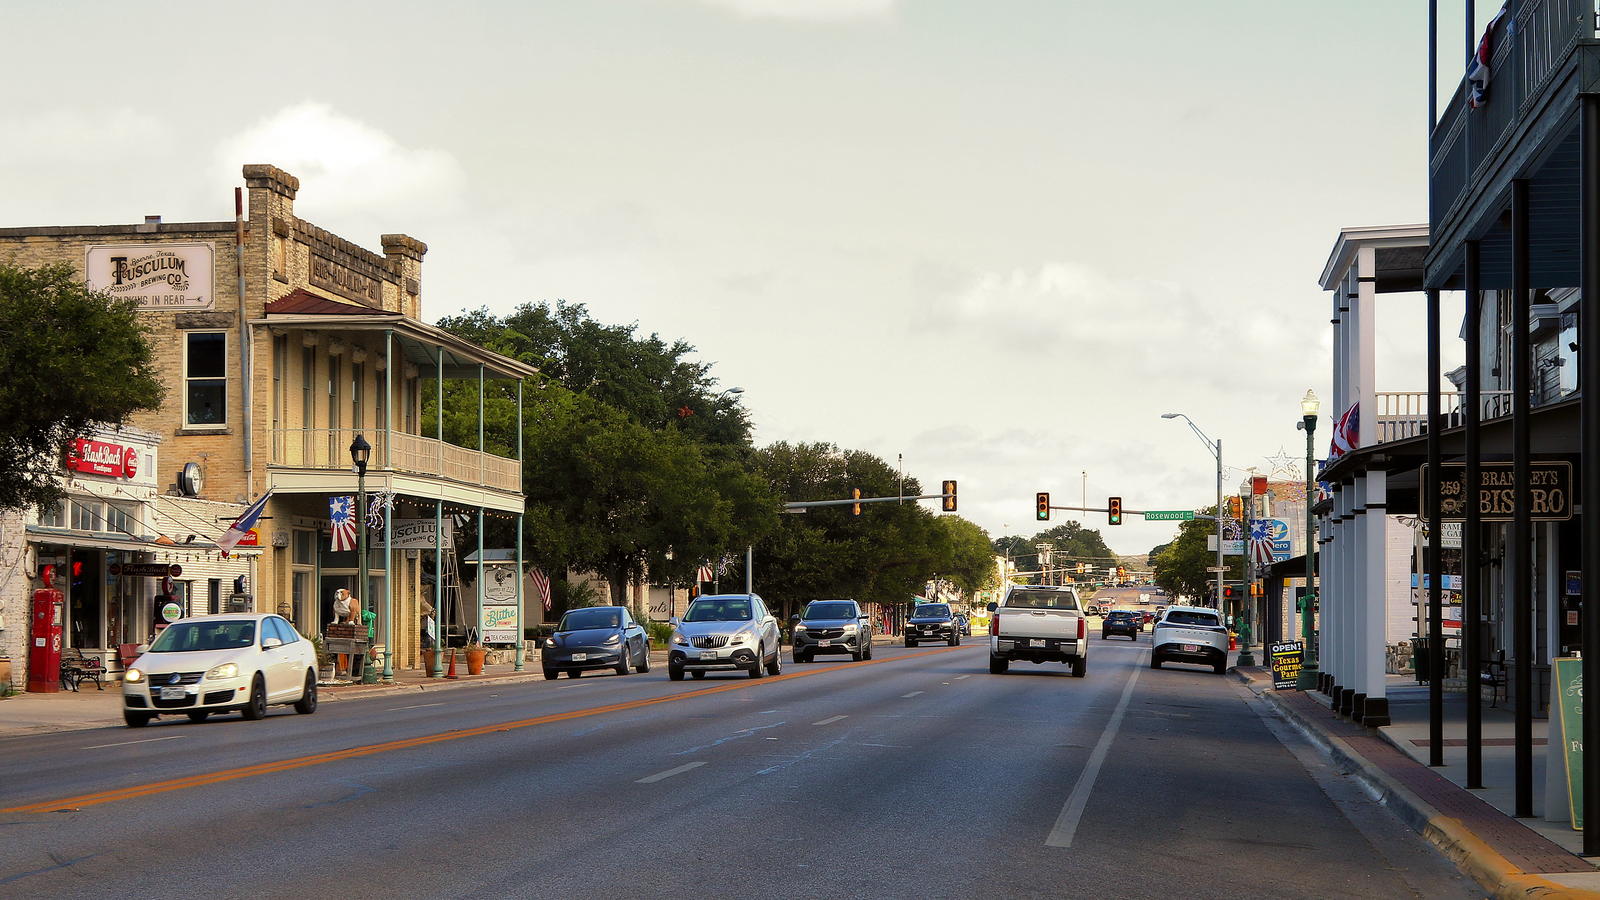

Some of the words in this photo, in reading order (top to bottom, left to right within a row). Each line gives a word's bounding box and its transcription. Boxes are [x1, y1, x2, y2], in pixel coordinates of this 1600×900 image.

[111, 257, 189, 285] TUSCULUM
[140, 274, 166, 287] BREWING
[152, 295, 160, 305] IN
[164, 295, 185, 304] REAR
[1480, 489, 1564, 513] BISRO
[484, 608, 516, 627] Blithe
[1272, 643, 1301, 652] OPEN!
[1279, 657, 1299, 665] Texas
[1273, 664, 1303, 672] Gourme
[1280, 670, 1298, 678] Pant
